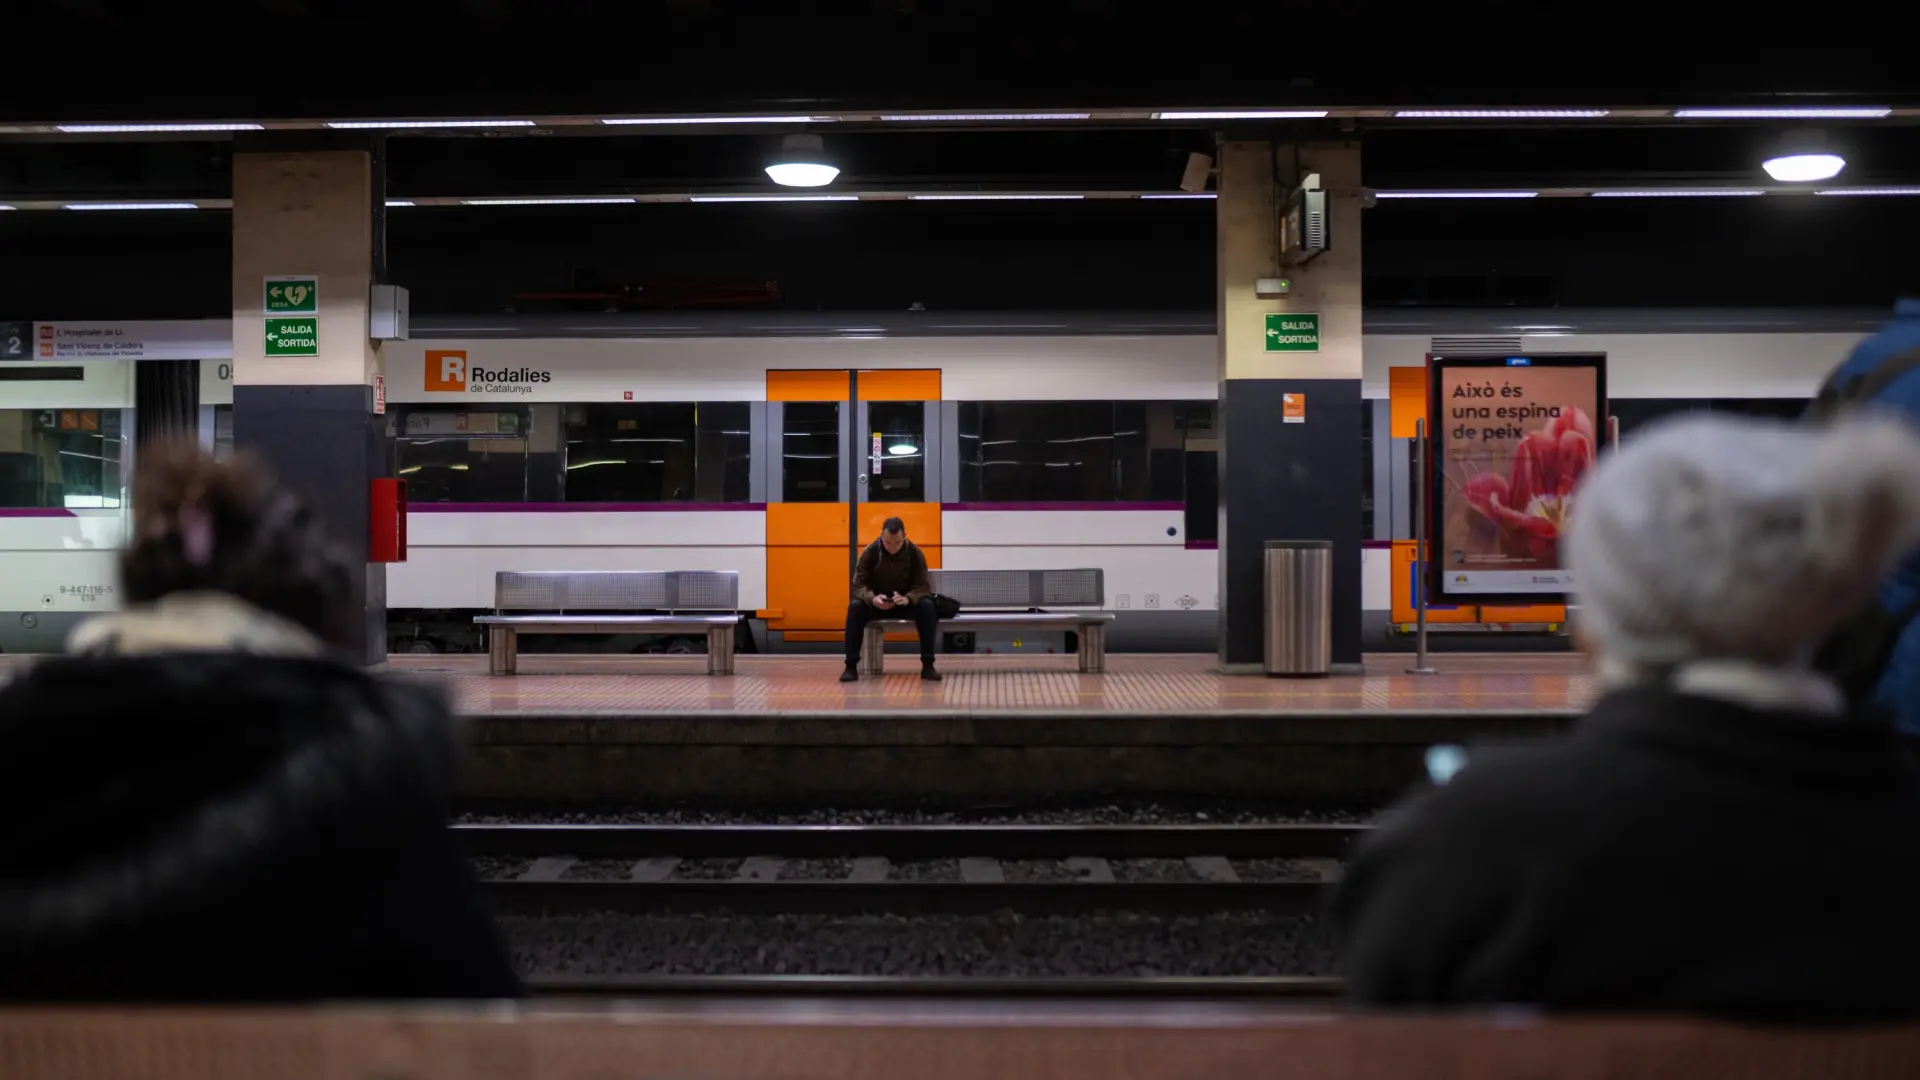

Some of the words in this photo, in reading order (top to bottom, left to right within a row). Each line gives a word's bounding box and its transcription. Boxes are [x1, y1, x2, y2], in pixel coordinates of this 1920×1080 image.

[280, 325, 312, 334] SALIDA
[1281, 321, 1314, 330] SALIDA
[8, 336, 21, 354] 2
[277, 339, 316, 348] SORTIDA
[1278, 335, 1318, 344] SORTIDA
[218, 363, 233, 380] 0
[441, 356, 465, 382] R
[472, 367, 551, 383] Rodalies
[470, 384, 483, 393] de
[485, 384, 532, 395] Catalunya
[1452, 382, 1495, 398] Això
[1501, 382, 1523, 398] és
[1452, 407, 1490, 419] una
[1496, 402, 1561, 422] espina
[1452, 424, 1476, 439] de
[1483, 424, 1523, 442] peix
